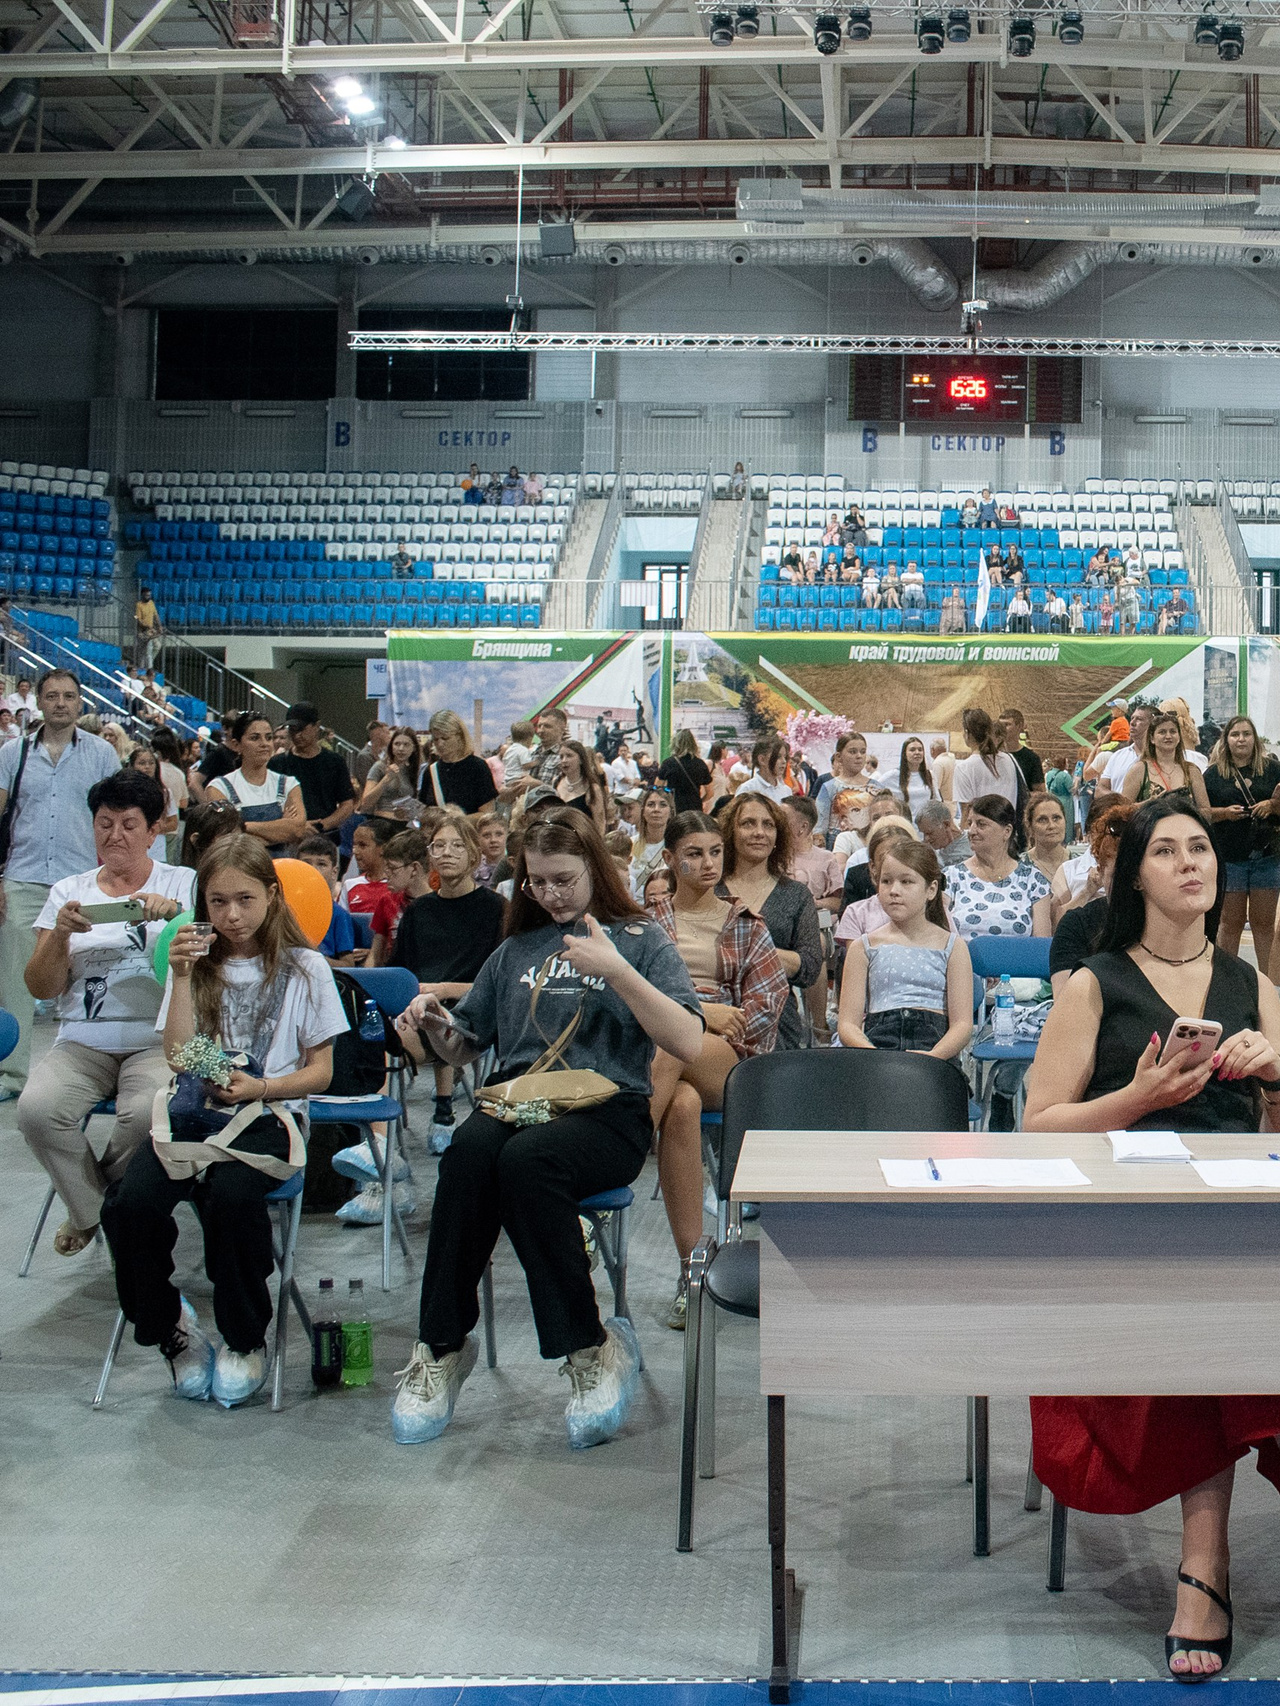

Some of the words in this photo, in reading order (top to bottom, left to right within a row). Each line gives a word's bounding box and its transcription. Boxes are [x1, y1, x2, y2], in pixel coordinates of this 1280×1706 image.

[951, 379, 986, 398] 15:26
[438, 430, 512, 447] СЕКТОР
[931, 434, 1006, 452] СЕКТОР
[472, 639, 552, 660] Брянщина
[848, 641, 889, 663] край
[892, 643, 965, 663] трудовой
[968, 646, 981, 661] и
[983, 643, 1060, 661] воинской
